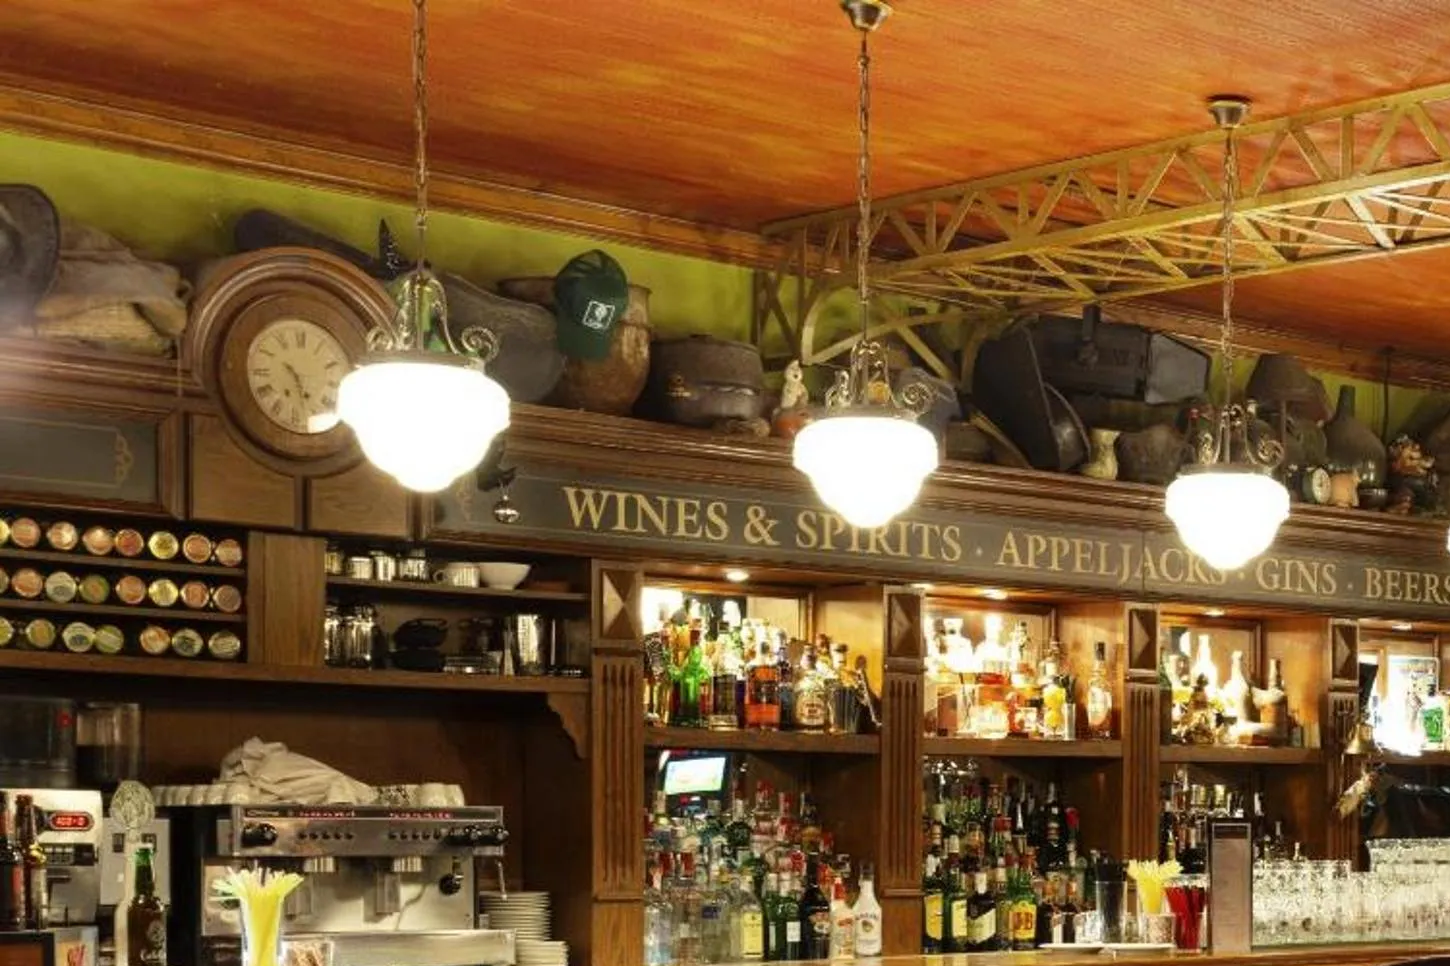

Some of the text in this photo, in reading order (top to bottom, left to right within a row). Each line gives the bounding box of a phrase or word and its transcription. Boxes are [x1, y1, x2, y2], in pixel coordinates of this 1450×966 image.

[563, 485, 730, 542] WINES
[743, 504, 781, 546] &
[795, 511, 963, 562] SPIRITS
[1256, 562, 1338, 596] GINS
